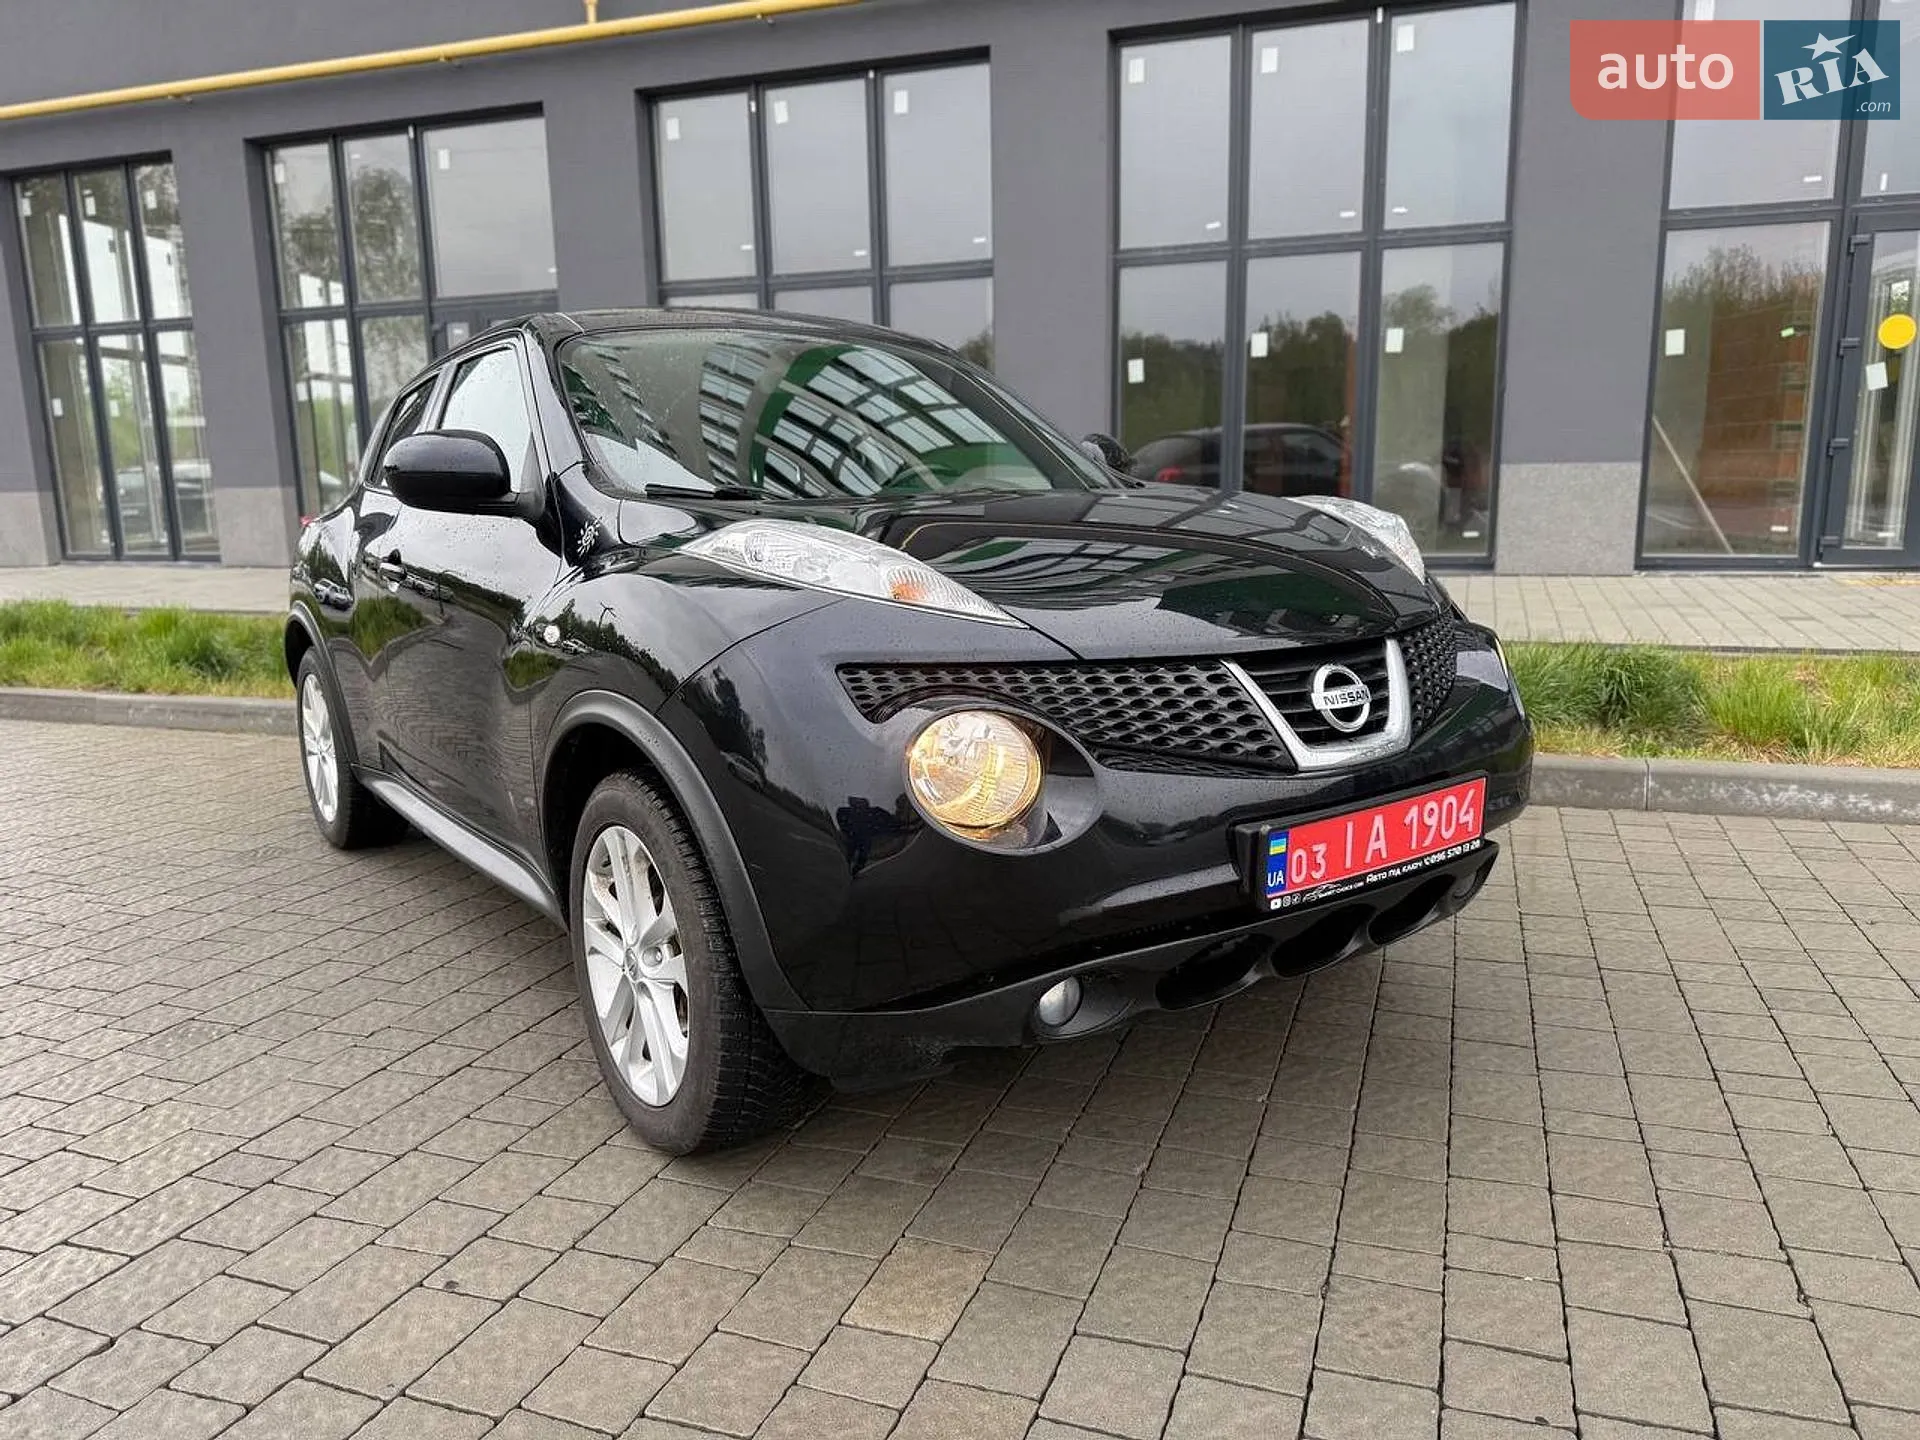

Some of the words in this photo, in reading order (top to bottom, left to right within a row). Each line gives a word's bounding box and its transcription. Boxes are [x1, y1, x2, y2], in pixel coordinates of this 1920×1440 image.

[1323, 690, 1369, 705] NISSAN
[1291, 843, 1327, 884] 03
[1404, 788, 1476, 850] 1904
[1267, 870, 1284, 887] UA
